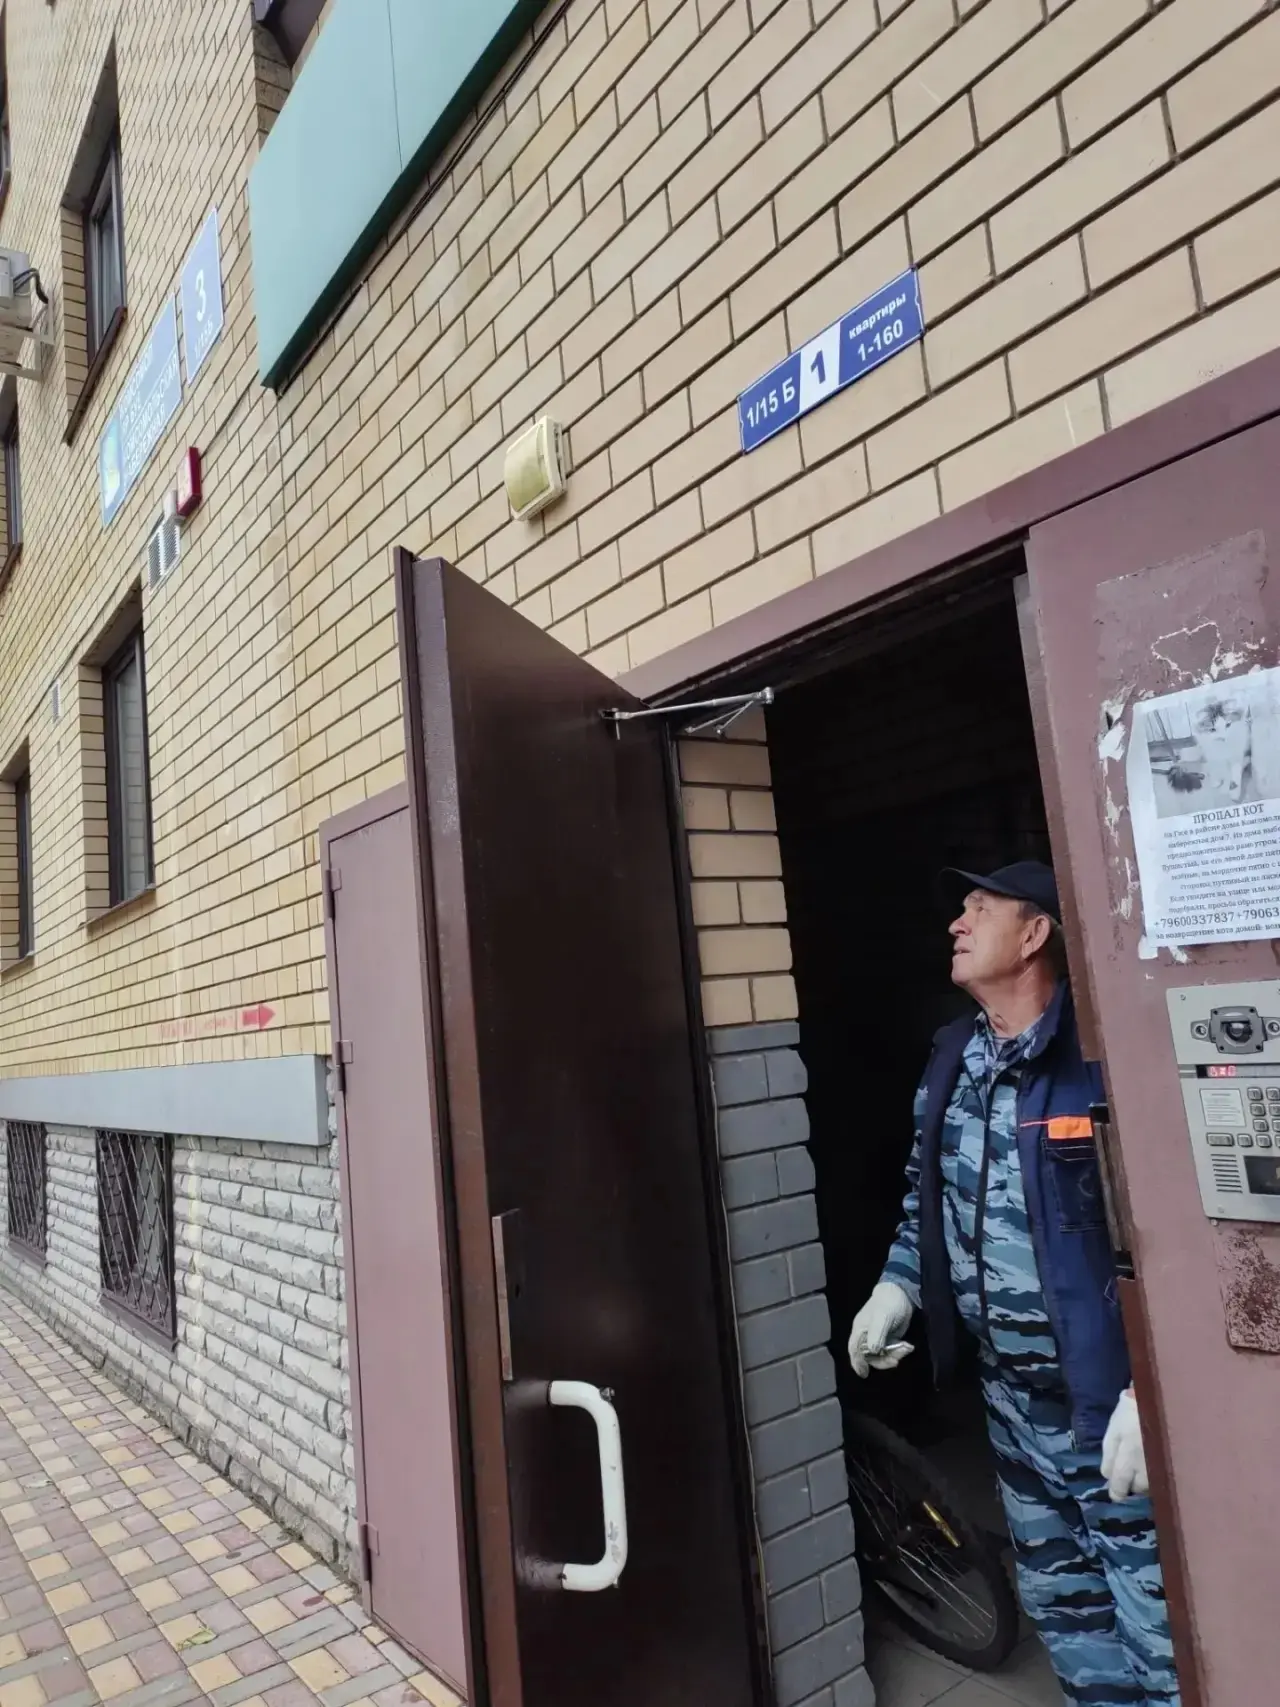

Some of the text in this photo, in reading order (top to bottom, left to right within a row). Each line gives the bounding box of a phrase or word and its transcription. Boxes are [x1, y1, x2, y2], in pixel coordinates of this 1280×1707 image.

[194, 268, 207, 323] 3
[849, 292, 906, 340] квартиры
[857, 318, 903, 362] 1-160
[810, 350, 826, 385] 1
[747, 377, 796, 428] 1/15 Б
[1193, 803, 1264, 824] ПРОПАЛ КОТ
[1195, 825, 1221, 836] районе
[1255, 839, 1276, 849] утром
[1154, 911, 1235, 929] +79600337837
